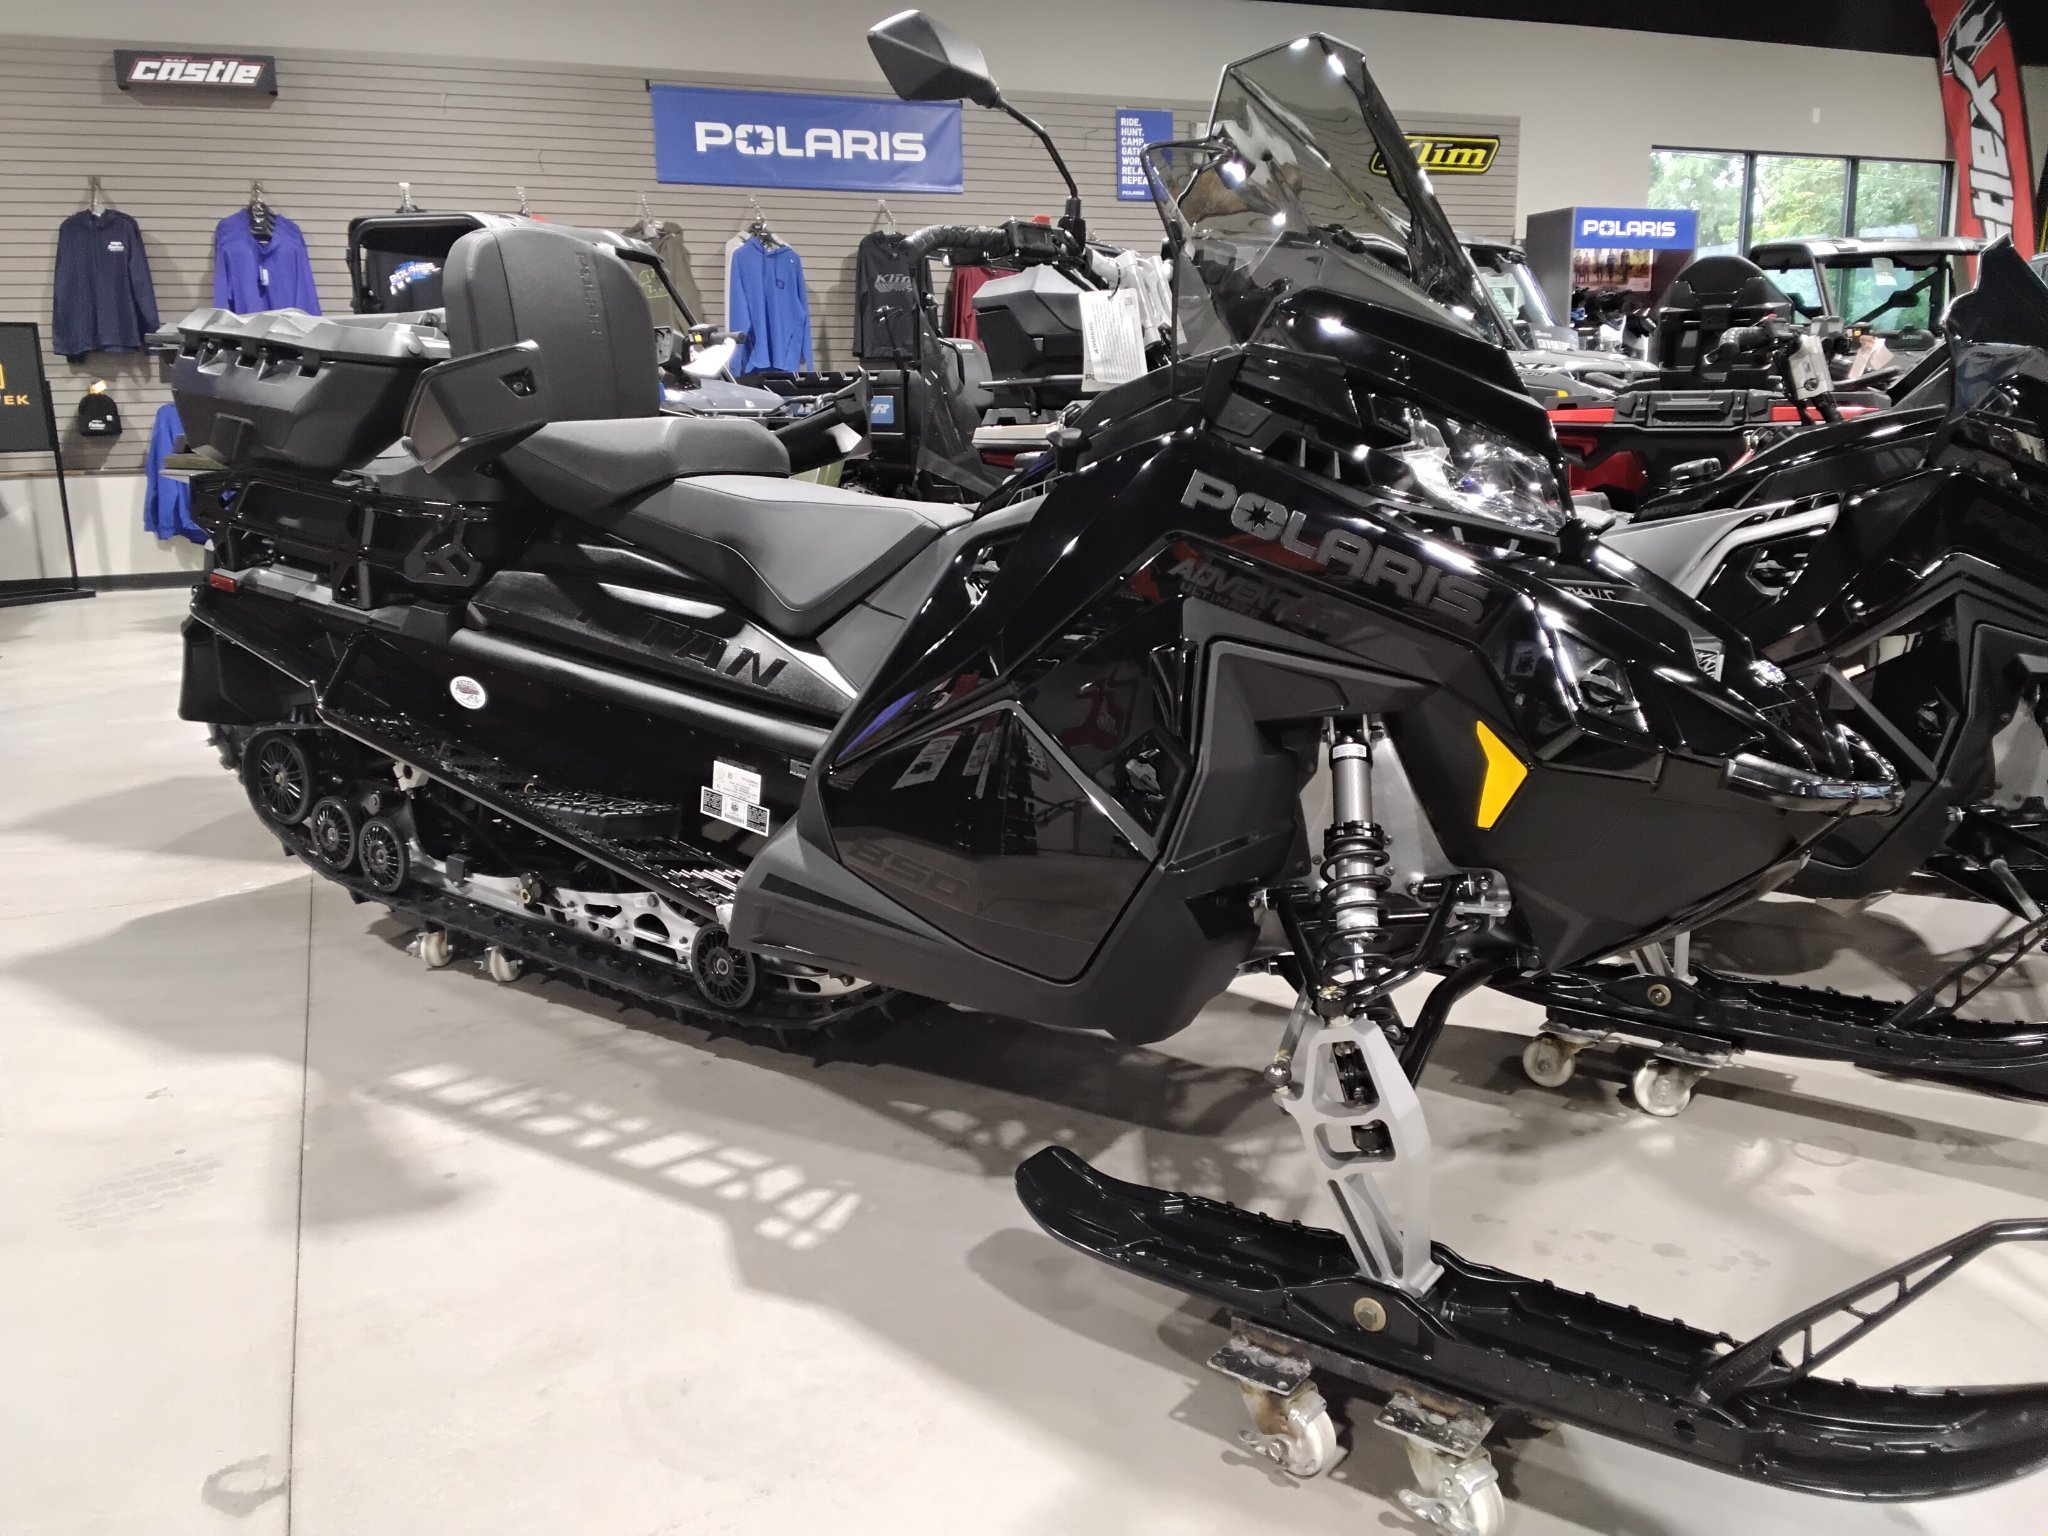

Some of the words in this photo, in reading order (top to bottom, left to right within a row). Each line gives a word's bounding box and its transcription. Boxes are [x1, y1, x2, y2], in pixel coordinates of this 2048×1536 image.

[1121, 117, 1142, 127] RIDE.
[1121, 128, 1145, 137] HUNT.
[695, 121, 927, 162] POLARIS
[1121, 138, 1145, 146] CAMP
[1121, 147, 1142, 156] GATH
[1122, 157, 1142, 165] WOR
[1122, 166, 1145, 175] RELA
[1122, 176, 1149, 185] REPEA
[1582, 219, 1676, 237] POLARIS
[389, 262, 435, 286] POLARIS
[0, 395, 30, 405] EK
[1180, 468, 1490, 625] POLARIS
